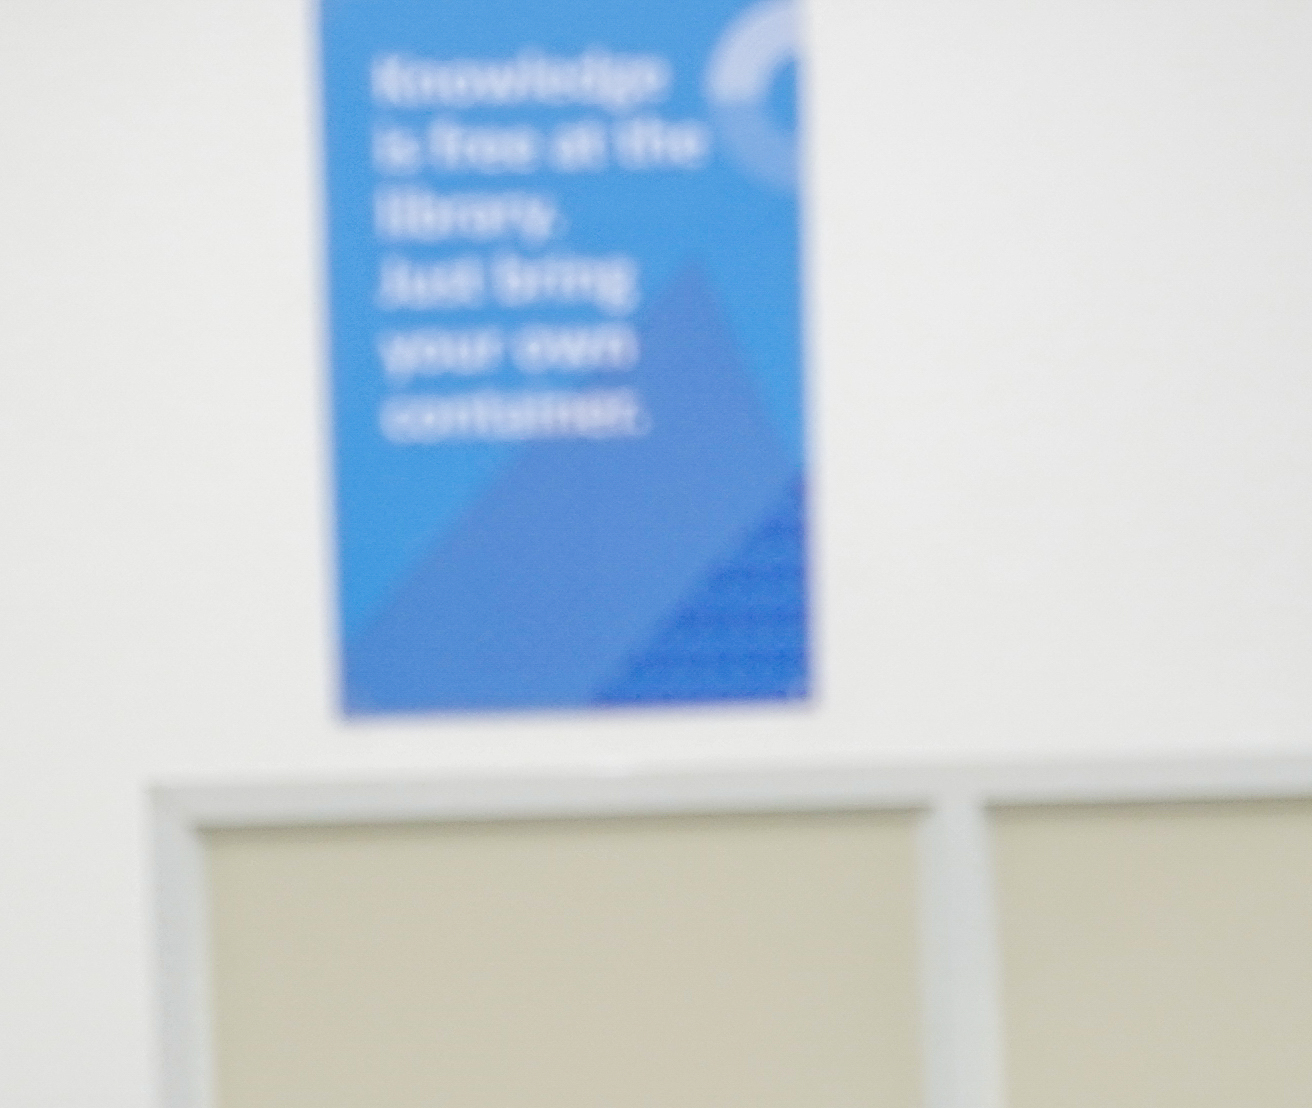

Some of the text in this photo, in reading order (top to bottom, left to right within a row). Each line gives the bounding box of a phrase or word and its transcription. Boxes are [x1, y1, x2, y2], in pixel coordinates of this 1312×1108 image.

[373, 50, 669, 111] Knowledge
[427, 113, 541, 173] free
[550, 117, 606, 172] at
[612, 111, 706, 169] the
[491, 251, 638, 317] bring
